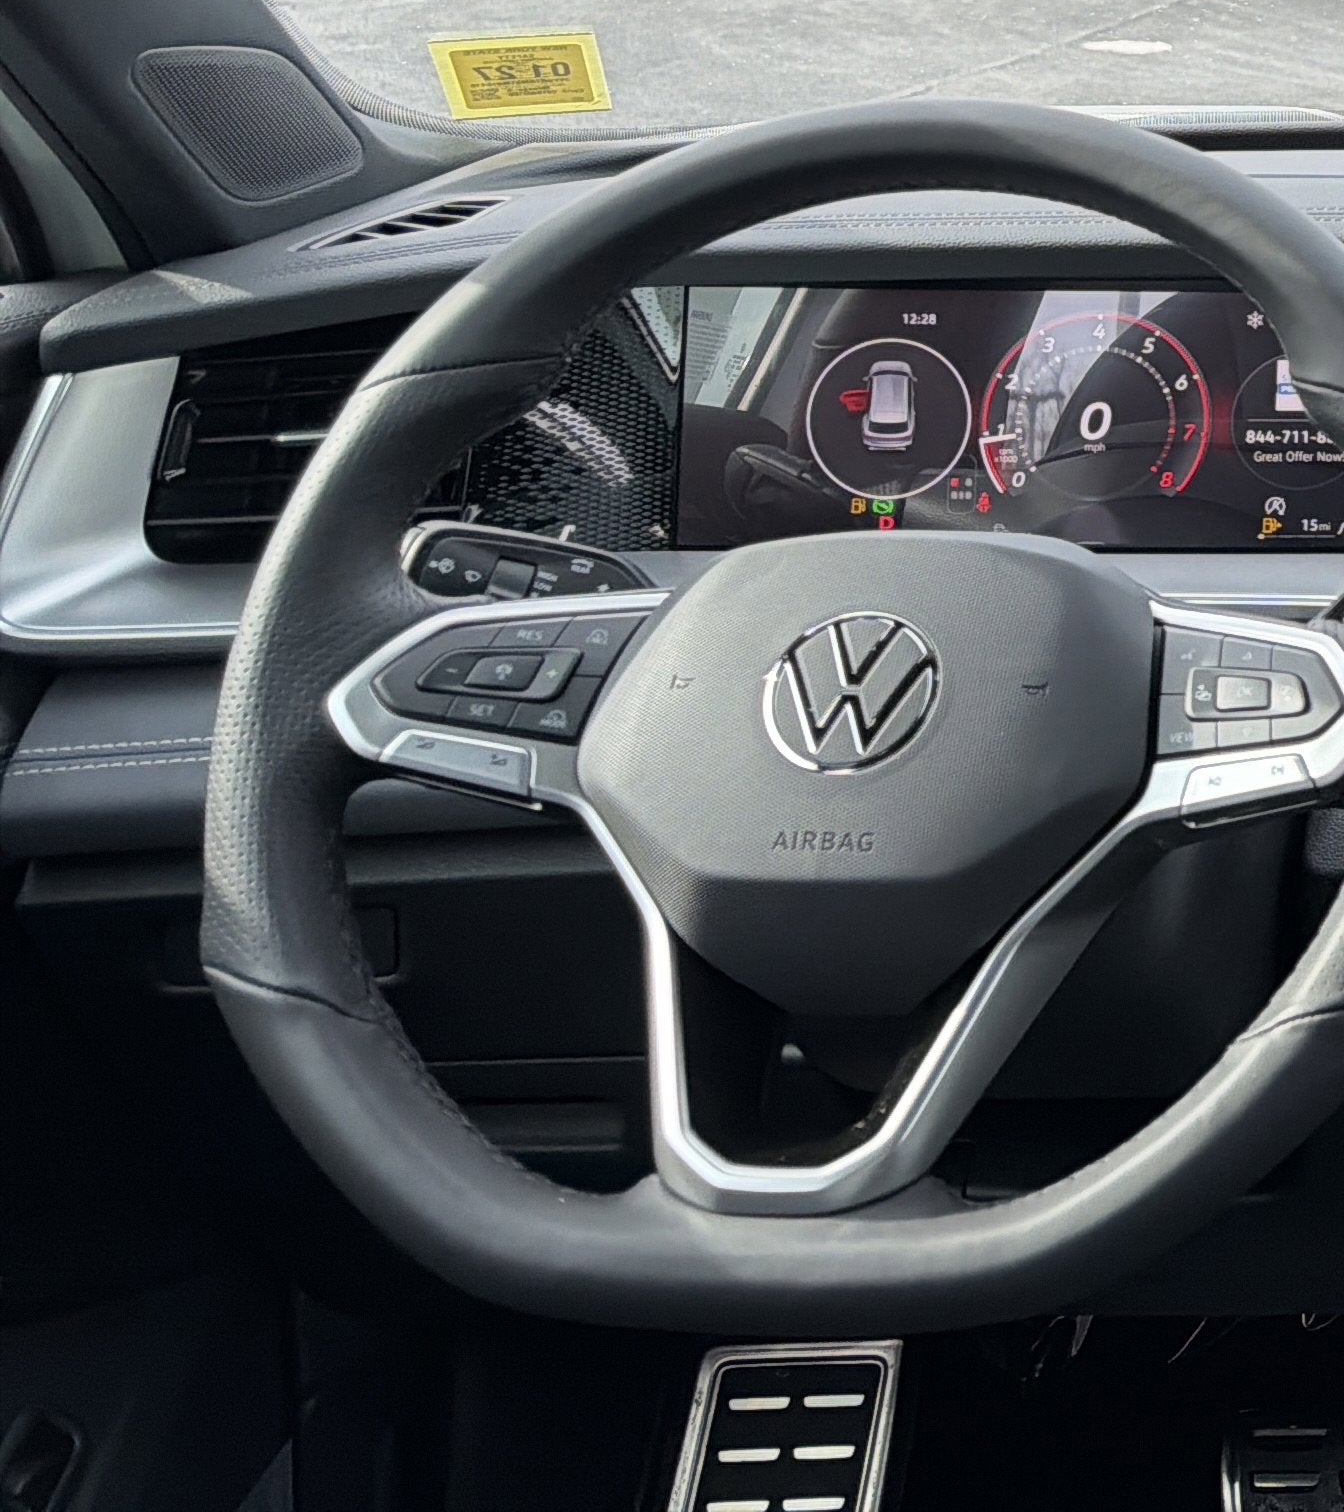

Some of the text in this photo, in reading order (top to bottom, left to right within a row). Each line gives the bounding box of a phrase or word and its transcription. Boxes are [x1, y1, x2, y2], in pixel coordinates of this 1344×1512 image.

[902, 313, 937, 326] 12:28
[1092, 324, 1106, 339] 4
[1041, 337, 1055, 353] 3
[1141, 337, 1156, 354] 5
[1004, 374, 1019, 390] 2
[1174, 374, 1189, 391] 6
[1079, 401, 1113, 441] 0
[1184, 423, 1197, 441] 7
[1244, 429, 1335, 445] 844-711-8
[1084, 443, 1106, 454] mph
[1253, 451, 1283, 463] Great
[1286, 451, 1314, 463] Offer
[1011, 471, 1026, 487] 0
[1159, 471, 1174, 488] 8
[516, 629, 543, 641] RES
[469, 703, 496, 717] SET
[772, 831, 875, 855] AIRBAG
